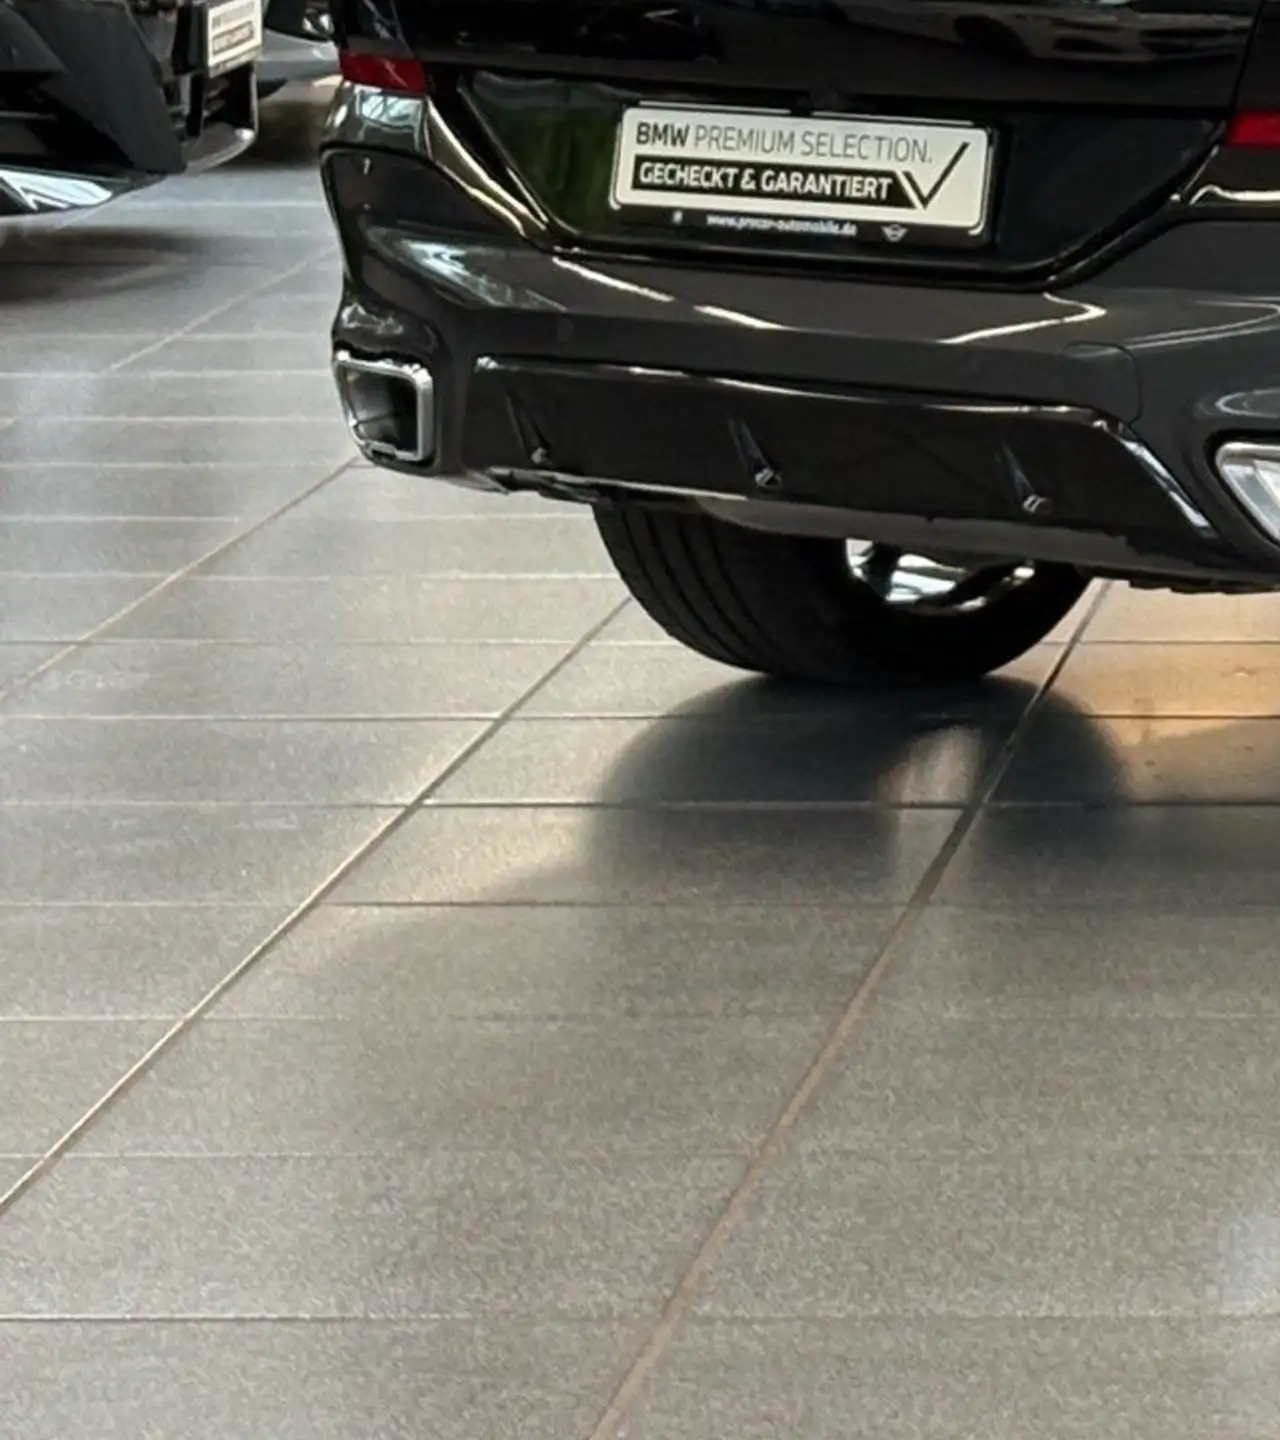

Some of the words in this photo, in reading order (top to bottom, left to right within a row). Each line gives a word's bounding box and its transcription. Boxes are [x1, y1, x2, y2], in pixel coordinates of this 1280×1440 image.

[636, 120, 689, 147] BMW
[694, 124, 795, 155] PREMIUM
[640, 162, 738, 190] GECHECKT
[740, 169, 756, 191] &
[761, 169, 893, 200] GARANTIERT
